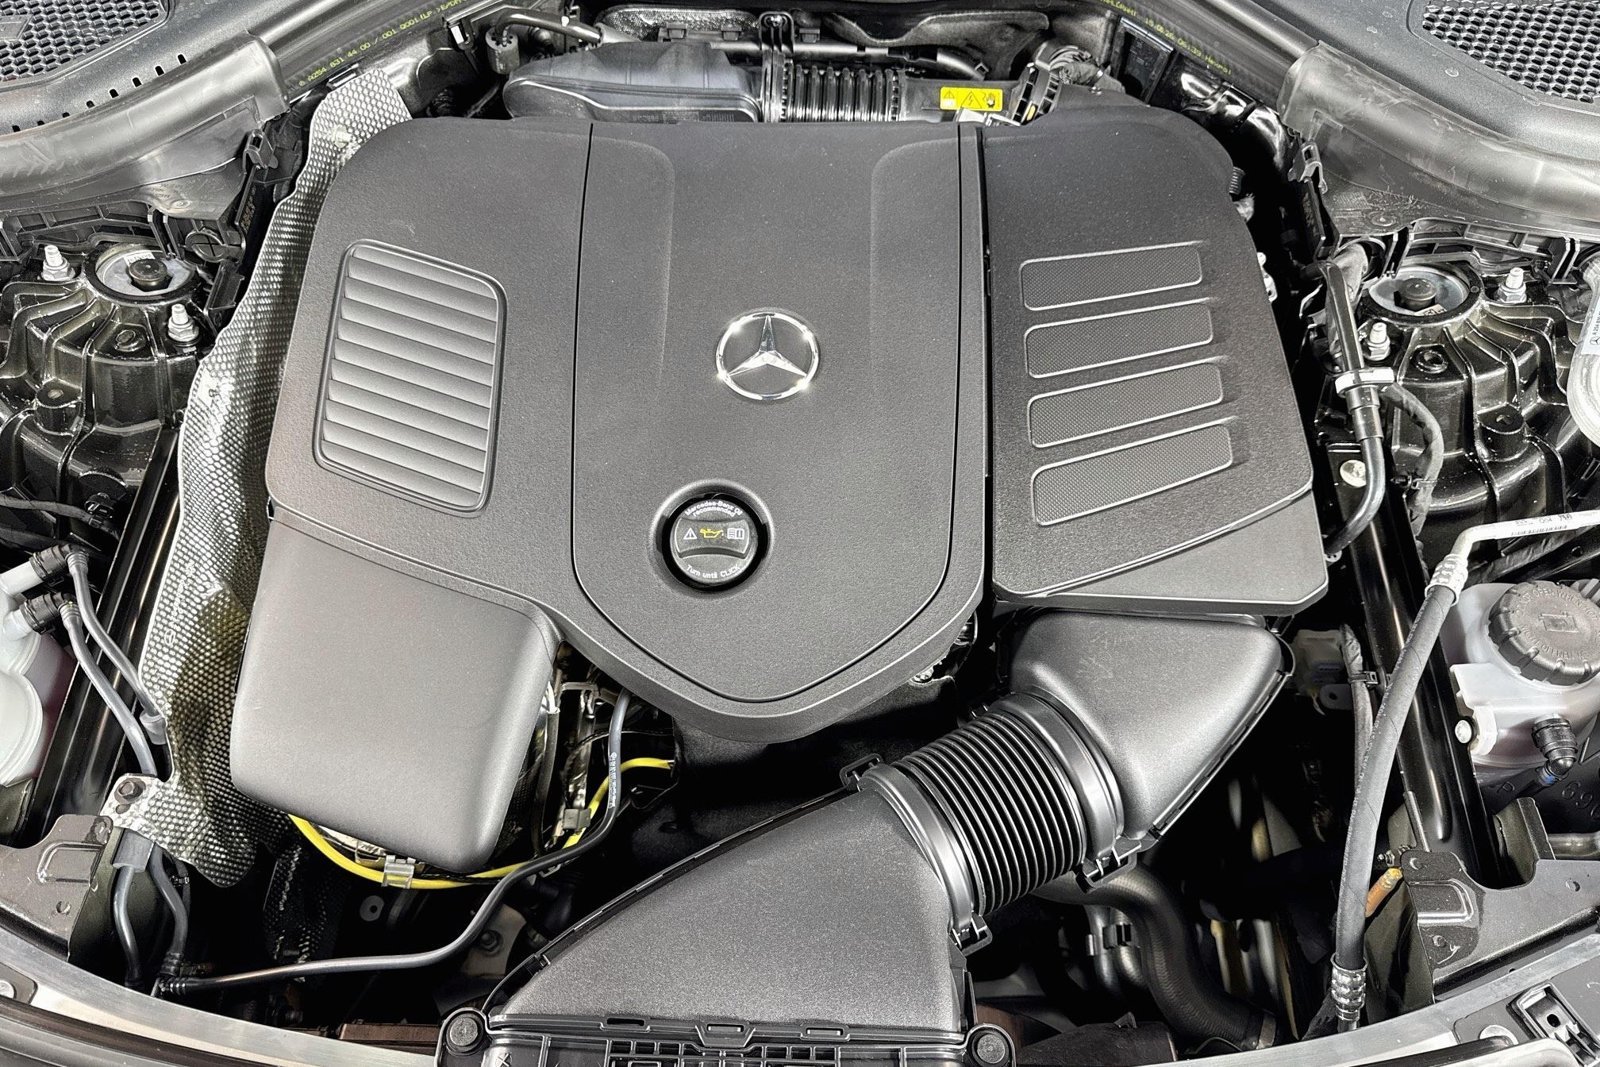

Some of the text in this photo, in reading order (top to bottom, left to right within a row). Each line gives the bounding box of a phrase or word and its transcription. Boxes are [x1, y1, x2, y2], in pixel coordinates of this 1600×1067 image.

[359, 42, 371, 51] 00
[381, 28, 397, 39] 001
[685, 501, 734, 516] Mercedes-Benz
[692, 506, 736, 517] recommended
[686, 563, 741, 579] Turn until CLICK
